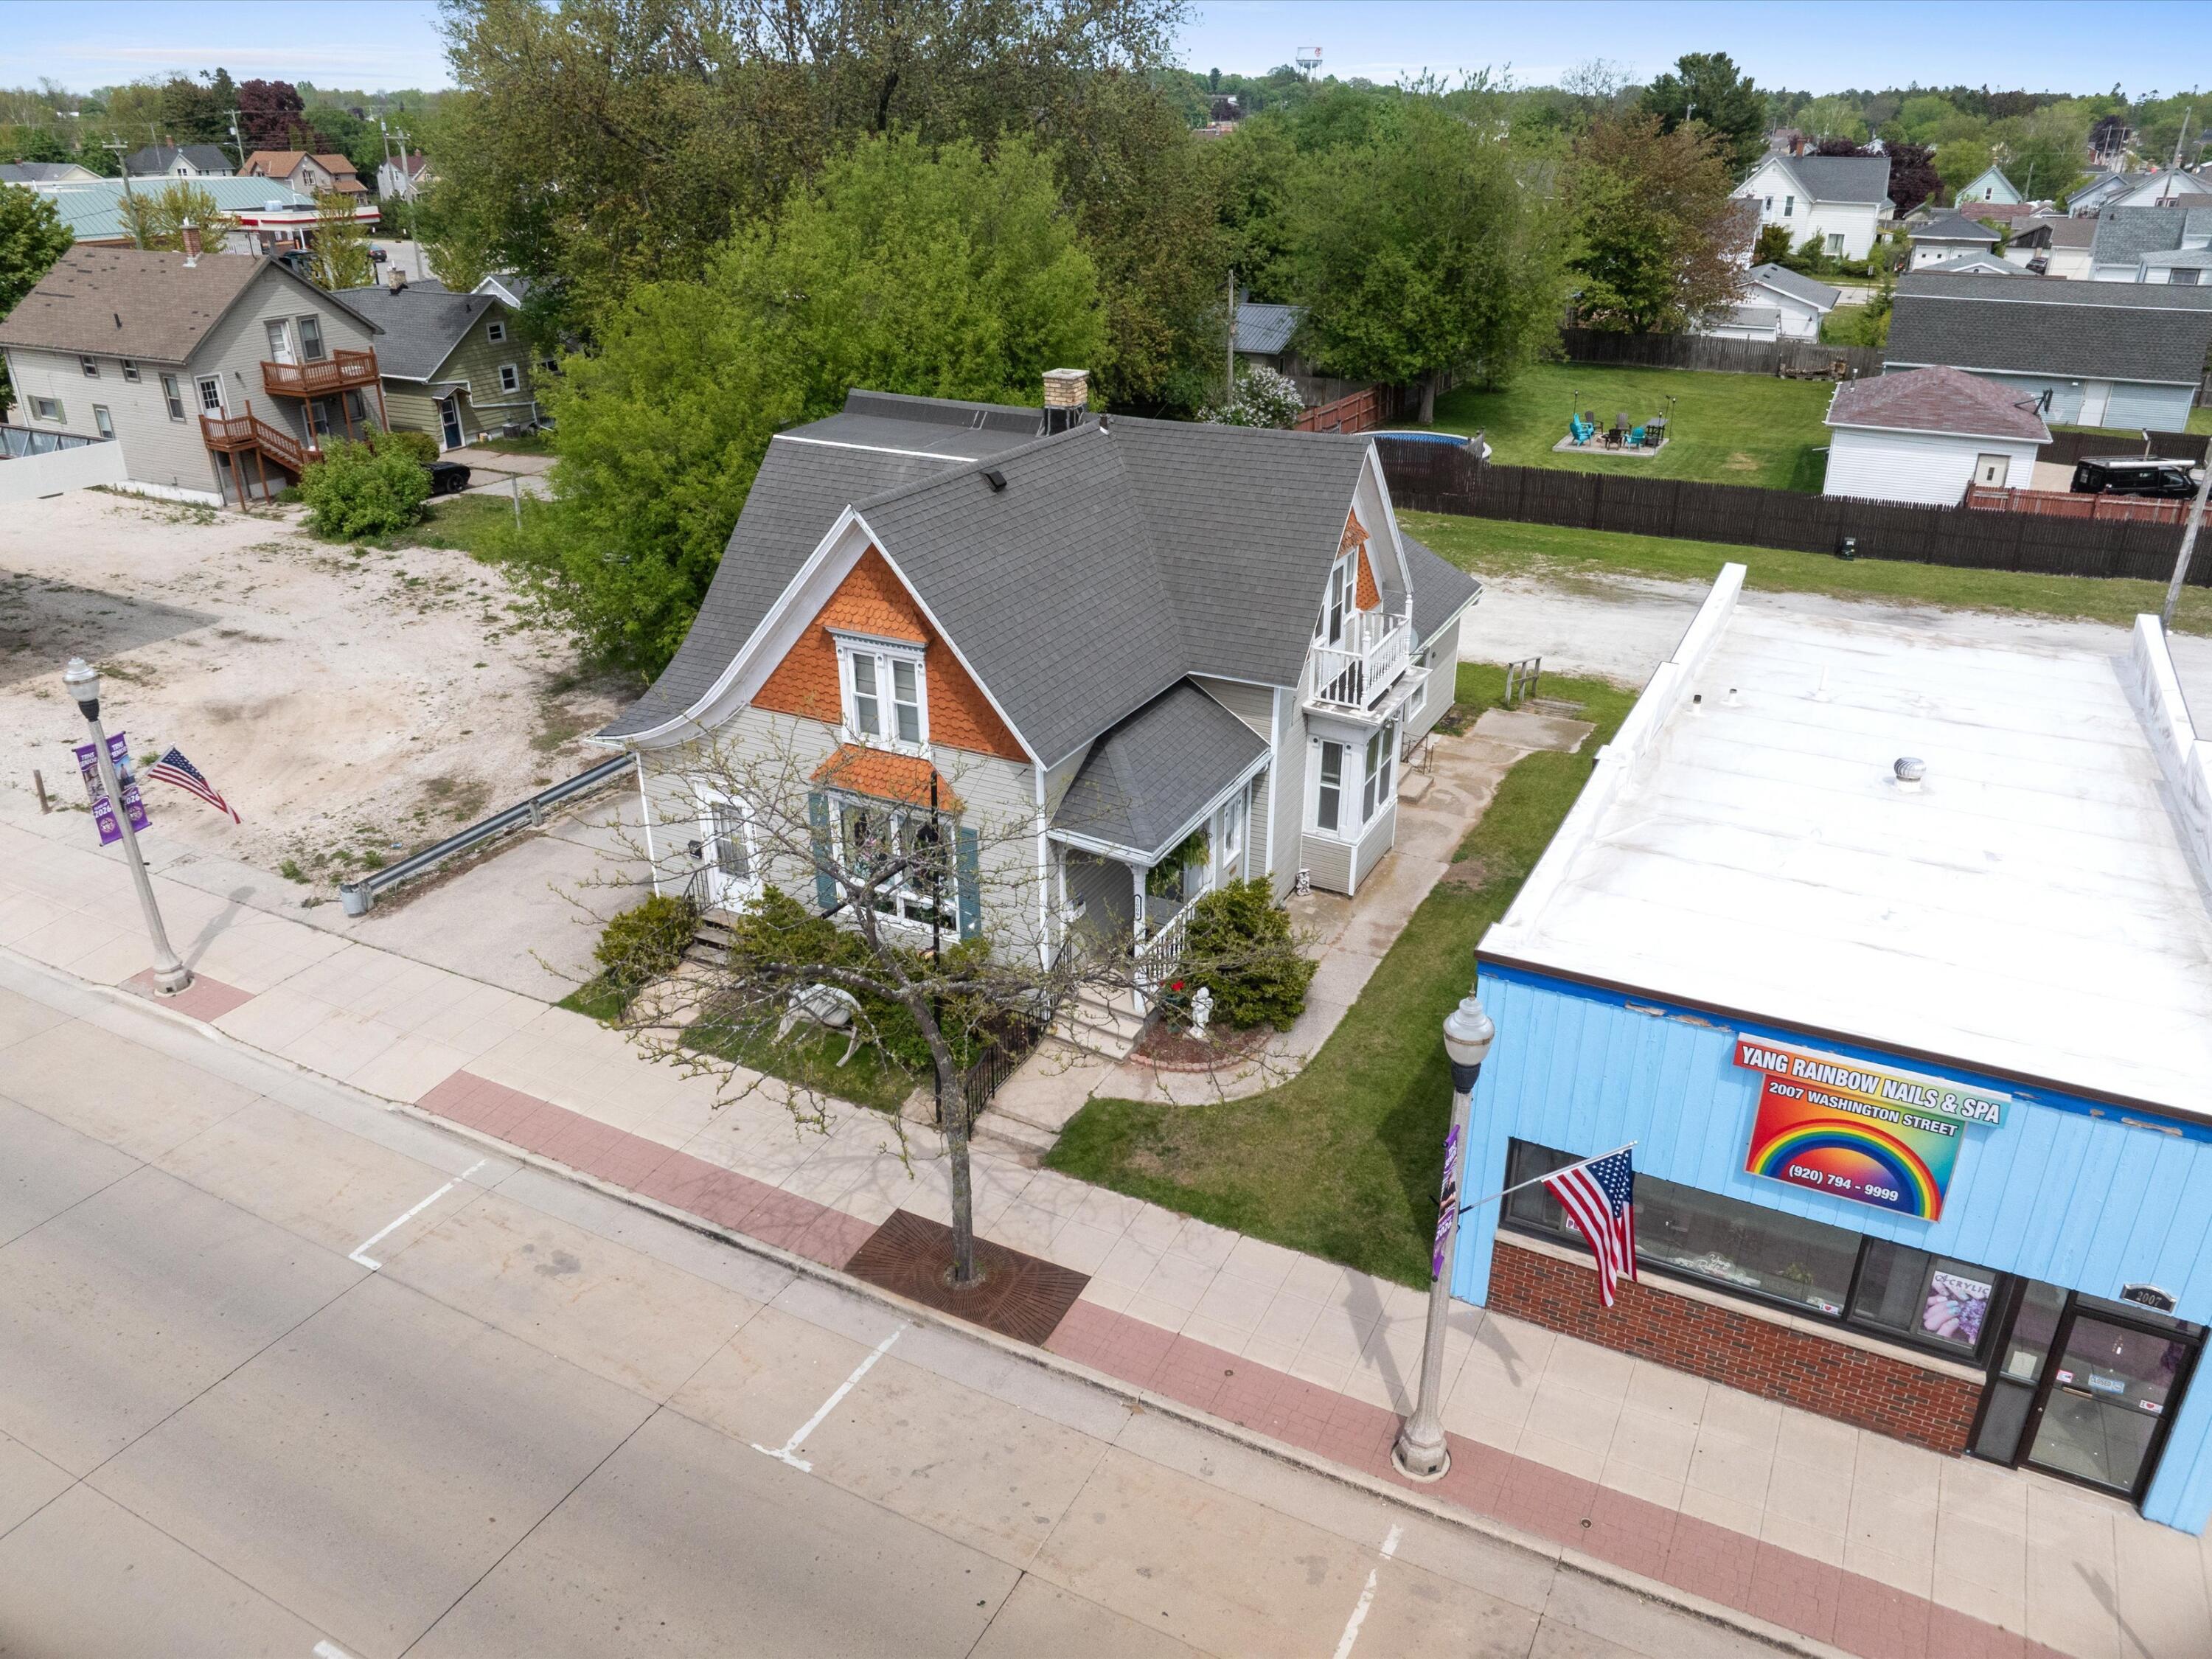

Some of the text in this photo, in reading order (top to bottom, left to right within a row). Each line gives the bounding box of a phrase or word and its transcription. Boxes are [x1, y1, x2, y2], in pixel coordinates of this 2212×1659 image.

[124, 793, 140, 804] 026
[94, 805, 112, 818] 2026
[1742, 1046, 2000, 1124] YANG RAINBOW NAILS & SPA
[1769, 1081, 1958, 1137] 2007 WASHINGTON STREET
[1789, 1164, 1823, 1184] (920)
[1827, 1174, 1851, 1190] 794
[1864, 1184, 1899, 1202] 9999
[1935, 1274, 1989, 1294] ACRYLIC
[2135, 1291, 2162, 1307] 2007
